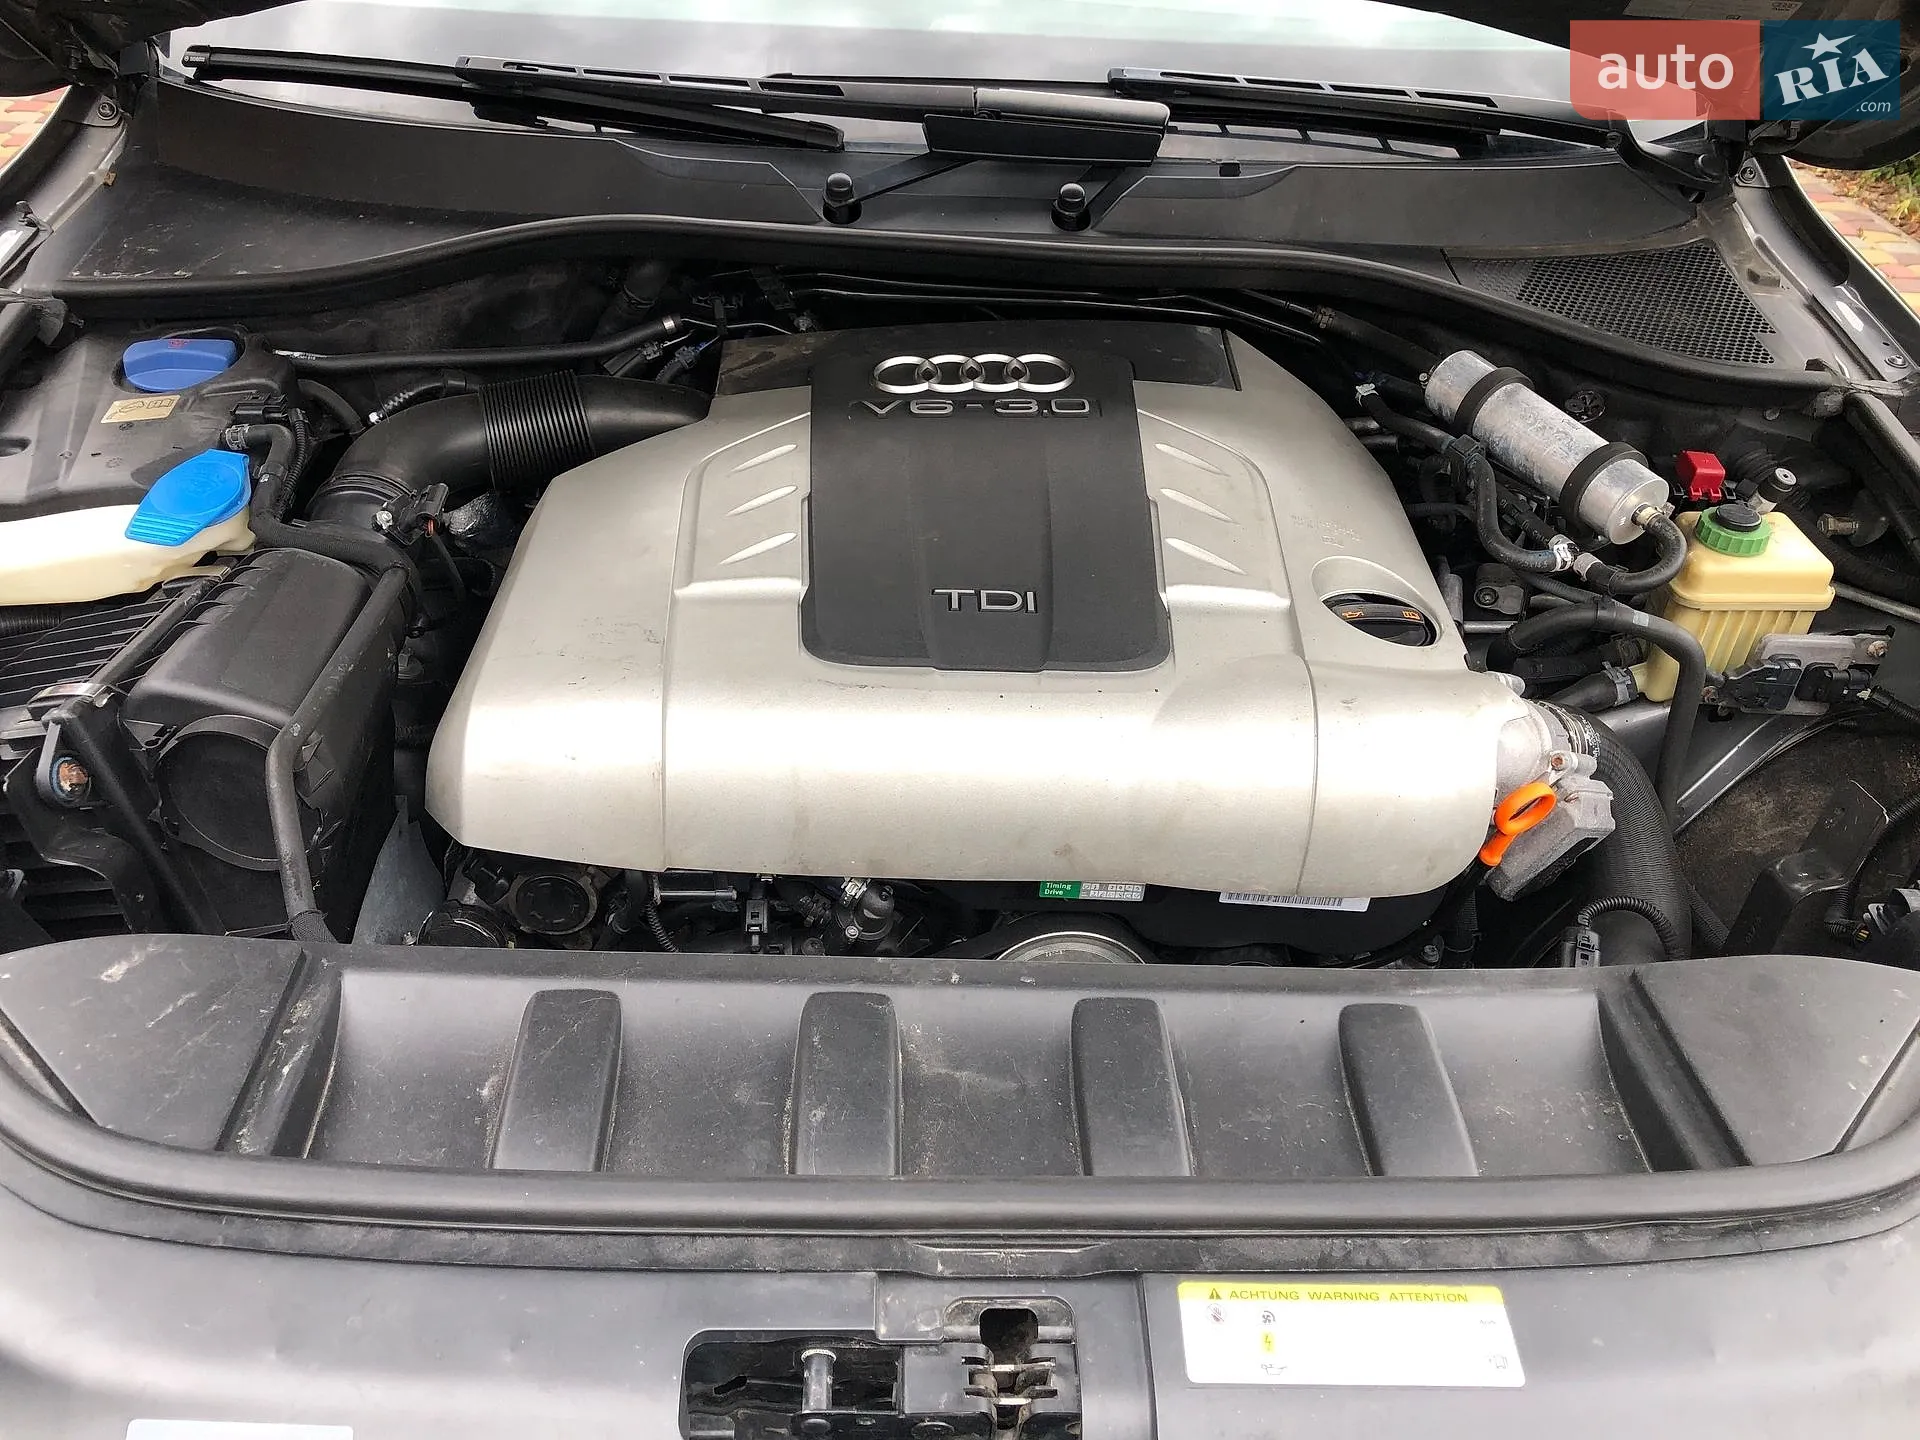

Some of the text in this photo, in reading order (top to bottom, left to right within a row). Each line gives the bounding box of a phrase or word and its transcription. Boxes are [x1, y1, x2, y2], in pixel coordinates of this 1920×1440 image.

[930, 588, 1038, 613] TDI
[1046, 882, 1072, 890] Timing
[1044, 888, 1064, 896] Drive
[1229, 1290, 1468, 1302] ACHTUNG WARNING ATTENTION
